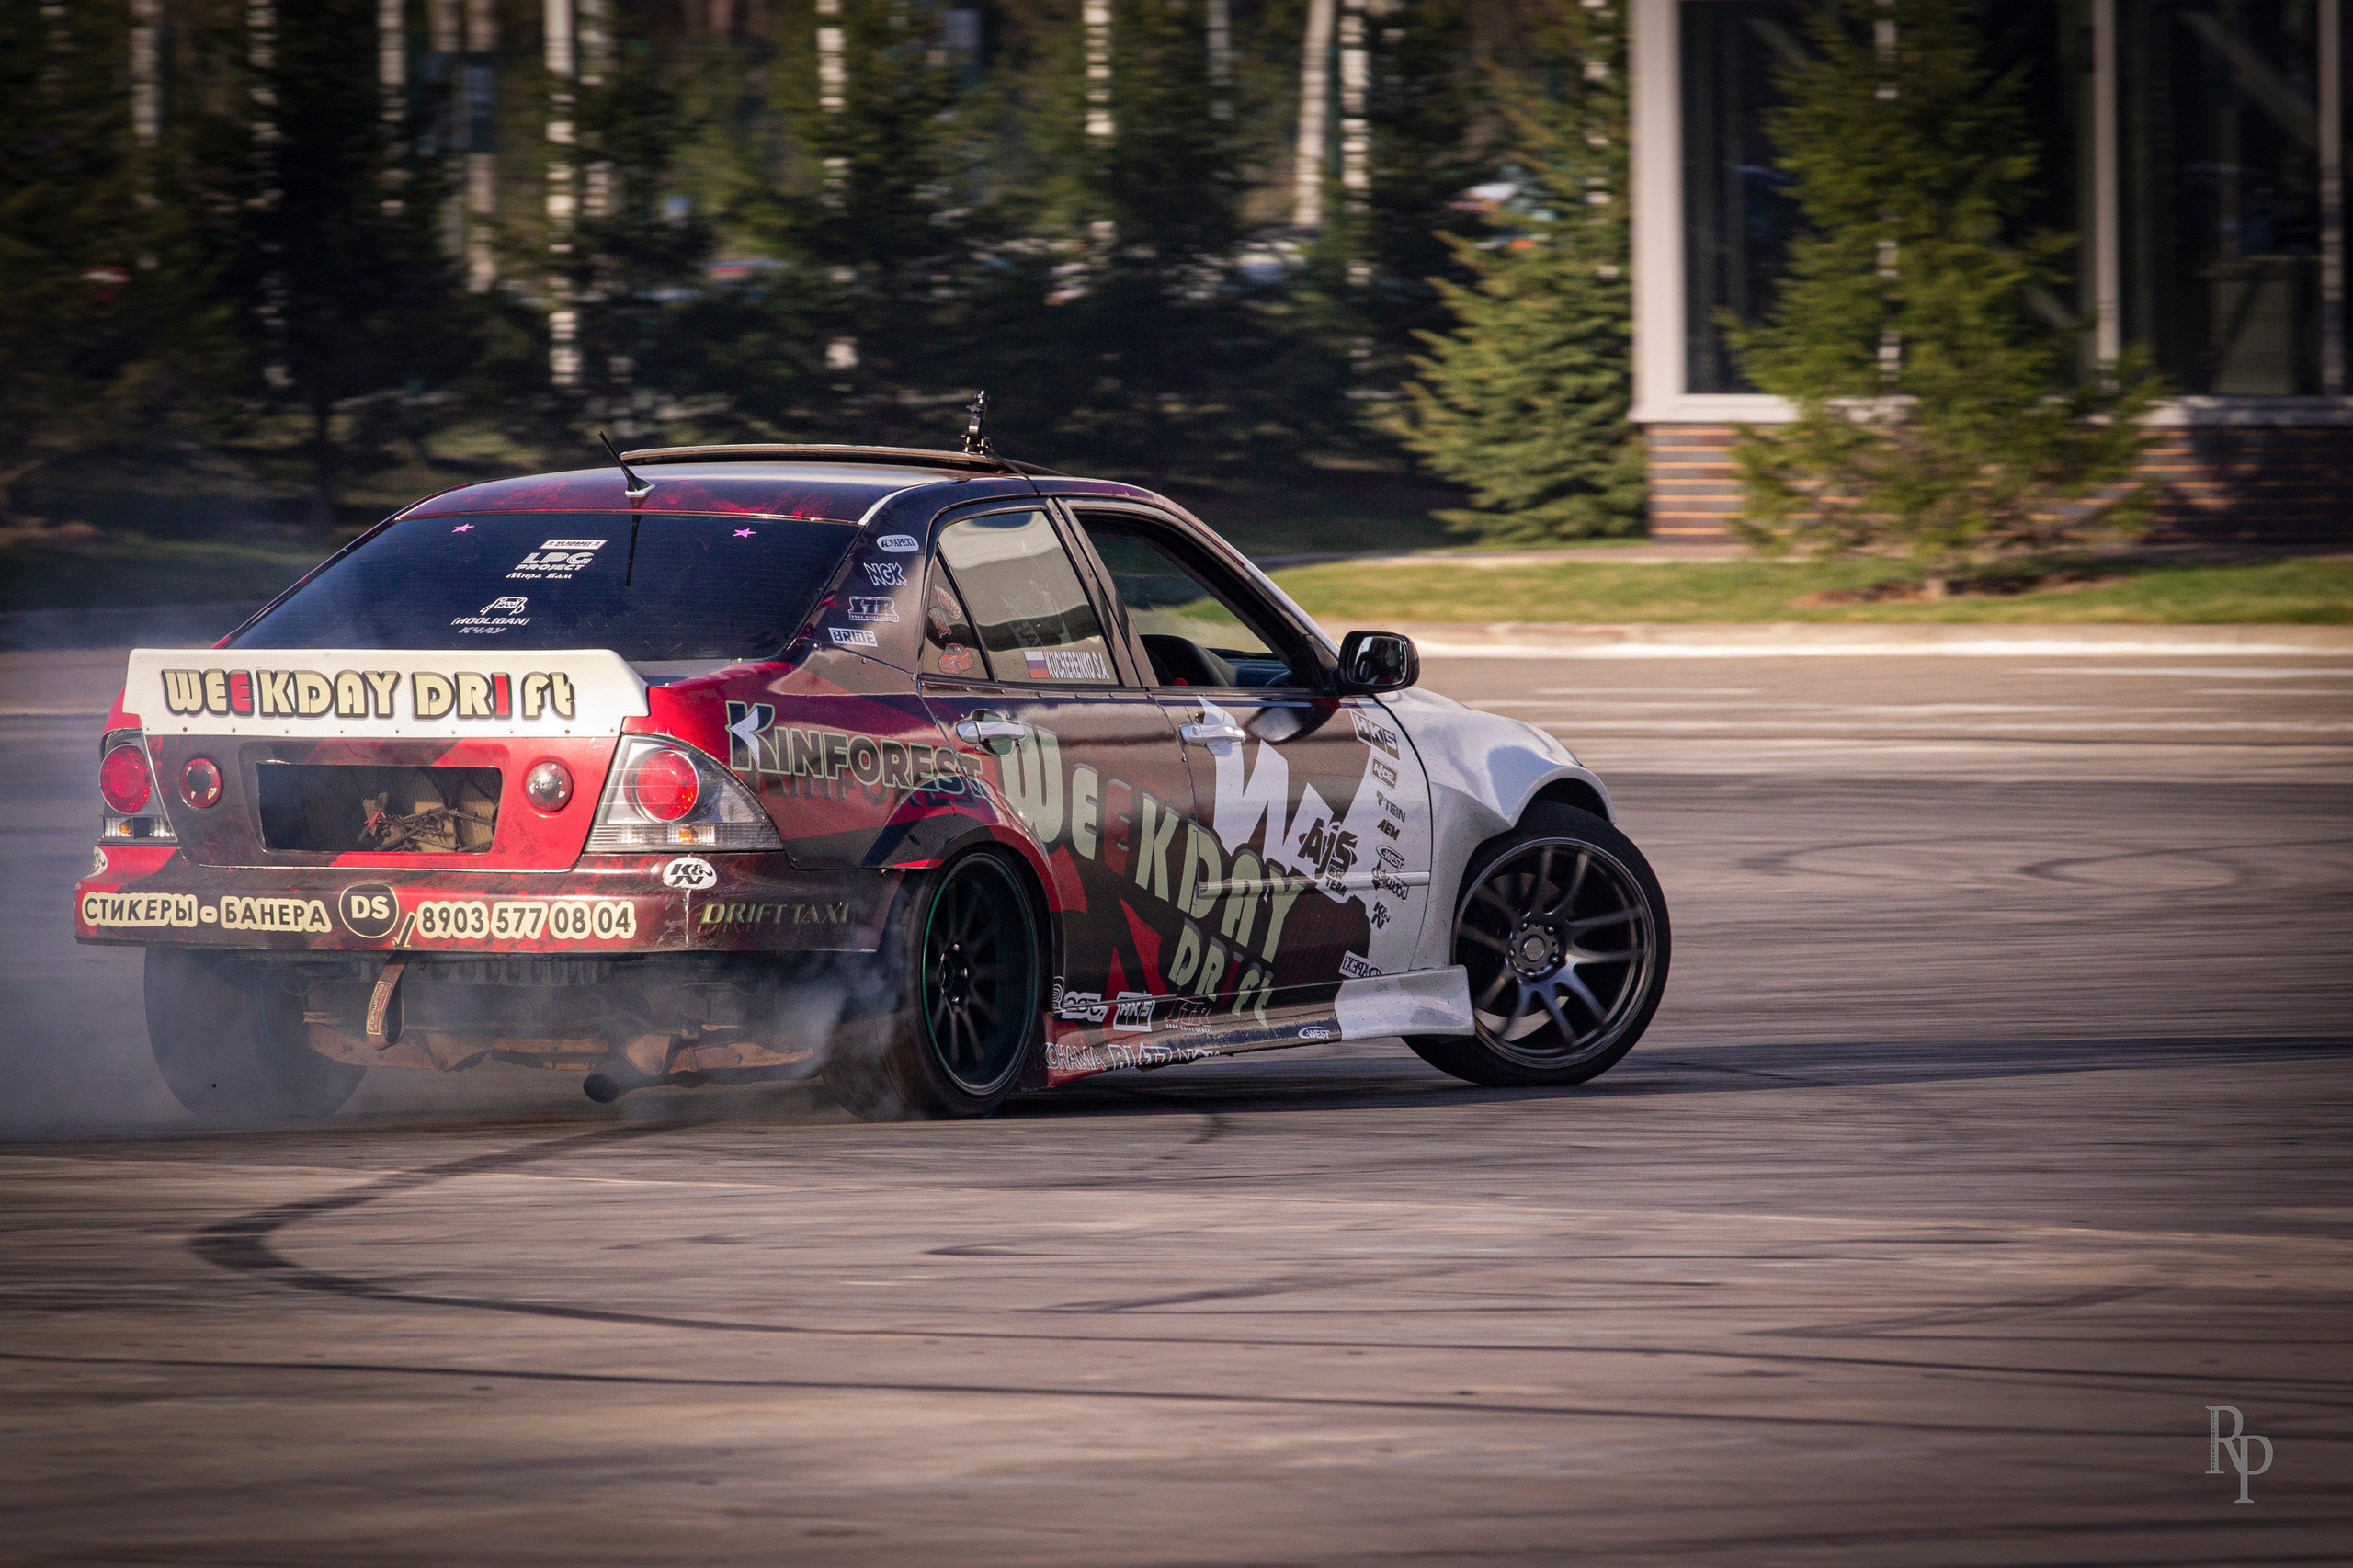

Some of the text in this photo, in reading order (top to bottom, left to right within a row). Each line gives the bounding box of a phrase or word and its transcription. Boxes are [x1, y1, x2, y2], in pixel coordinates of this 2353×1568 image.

[521, 551, 594, 564] LPG
[863, 562, 907, 586] NGK
[831, 629, 876, 644] BRIDE
[1044, 651, 1110, 679] KUCHERENKO S.A.
[162, 668, 402, 720] WEEKDAY
[1353, 712, 1398, 752] HKS
[726, 700, 987, 799] KINFOREST
[1384, 797, 1406, 823] TEIN
[997, 721, 1309, 963] WEEKDAY
[1377, 819, 1400, 841] AEM
[1325, 877, 1349, 897] TEAM
[85, 897, 193, 922] СТИКЕРЫ
[224, 902, 326, 927] БАНЕРА
[350, 894, 390, 920] DS
[422, 906, 631, 934] 8903 577 08 04
[699, 902, 850, 925] DRIFT TAXI
[1117, 1001, 1152, 1017] HKS
